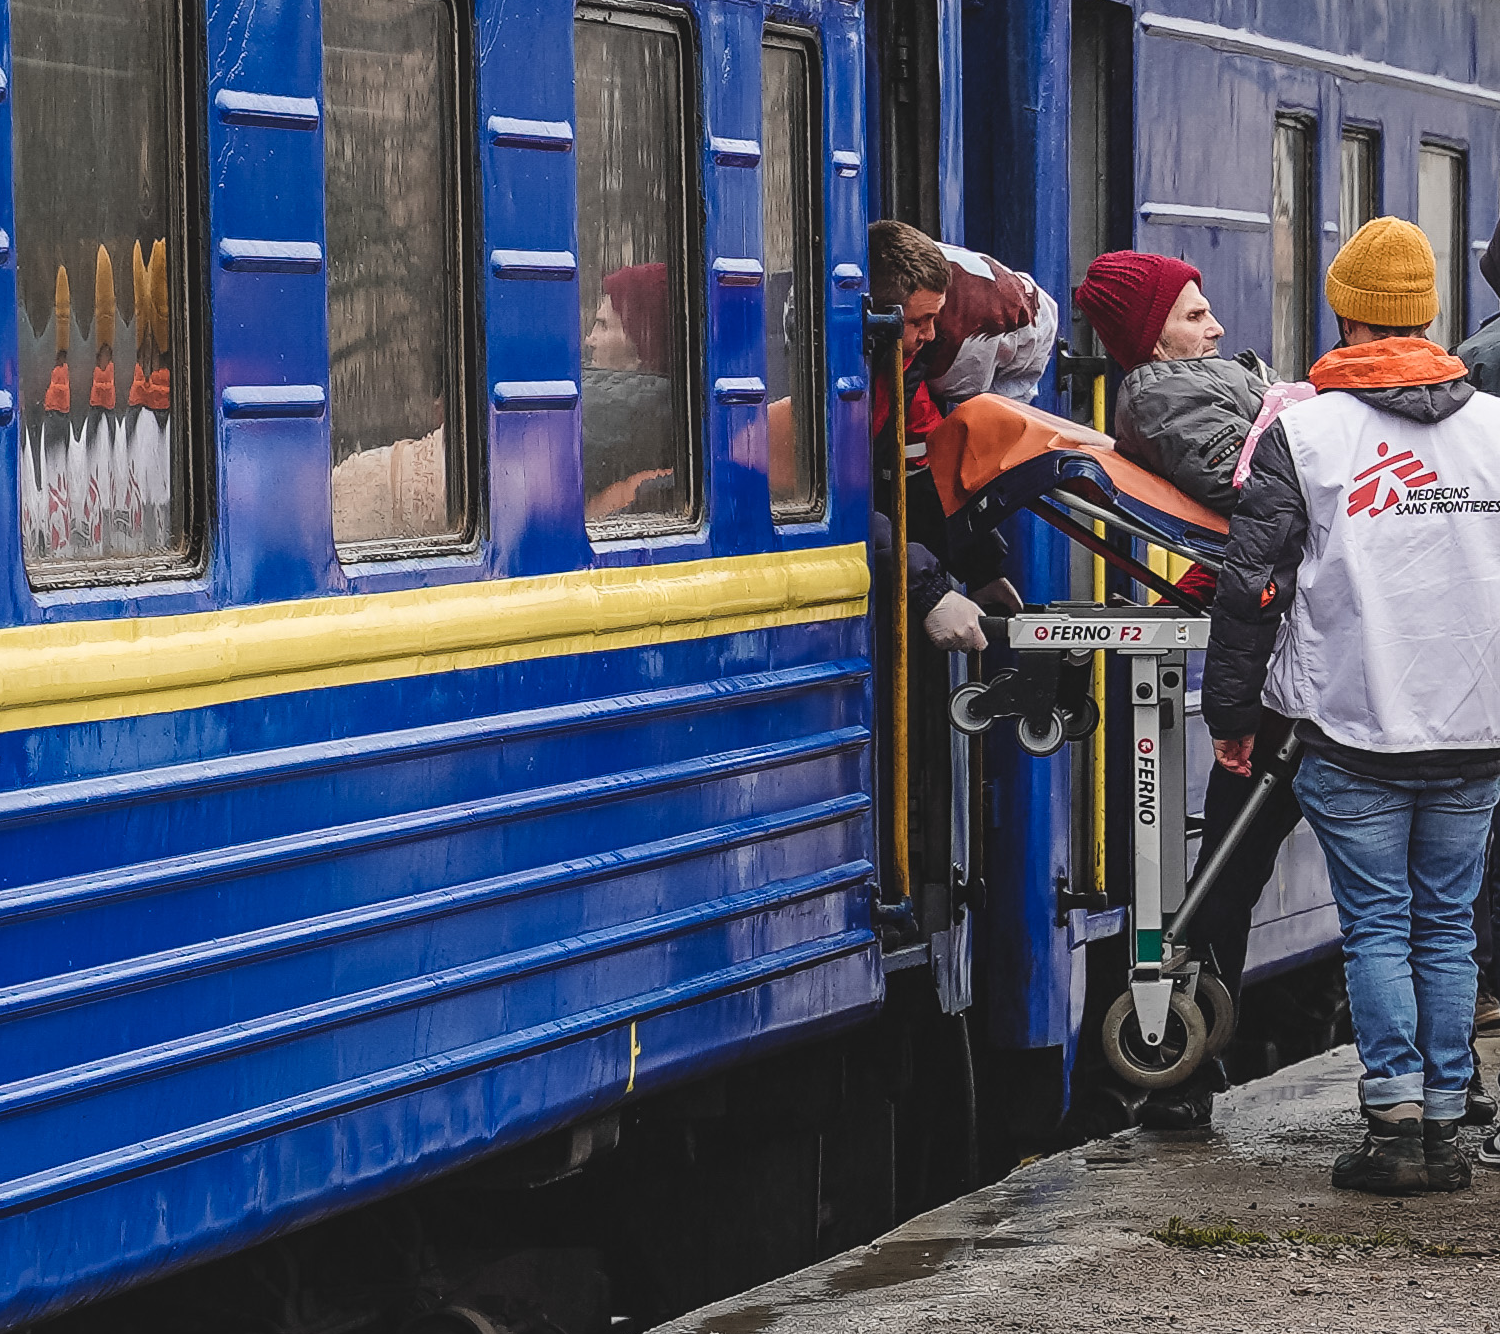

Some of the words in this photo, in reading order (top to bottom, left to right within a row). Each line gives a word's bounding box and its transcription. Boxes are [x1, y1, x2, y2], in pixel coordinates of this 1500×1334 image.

[1405, 486, 1470, 502] MEDECINS
[1394, 503, 1427, 516] SANS
[1050, 625, 1111, 641] FERNO
[1119, 626, 1143, 642] F2
[1138, 756, 1156, 826] FERNO
